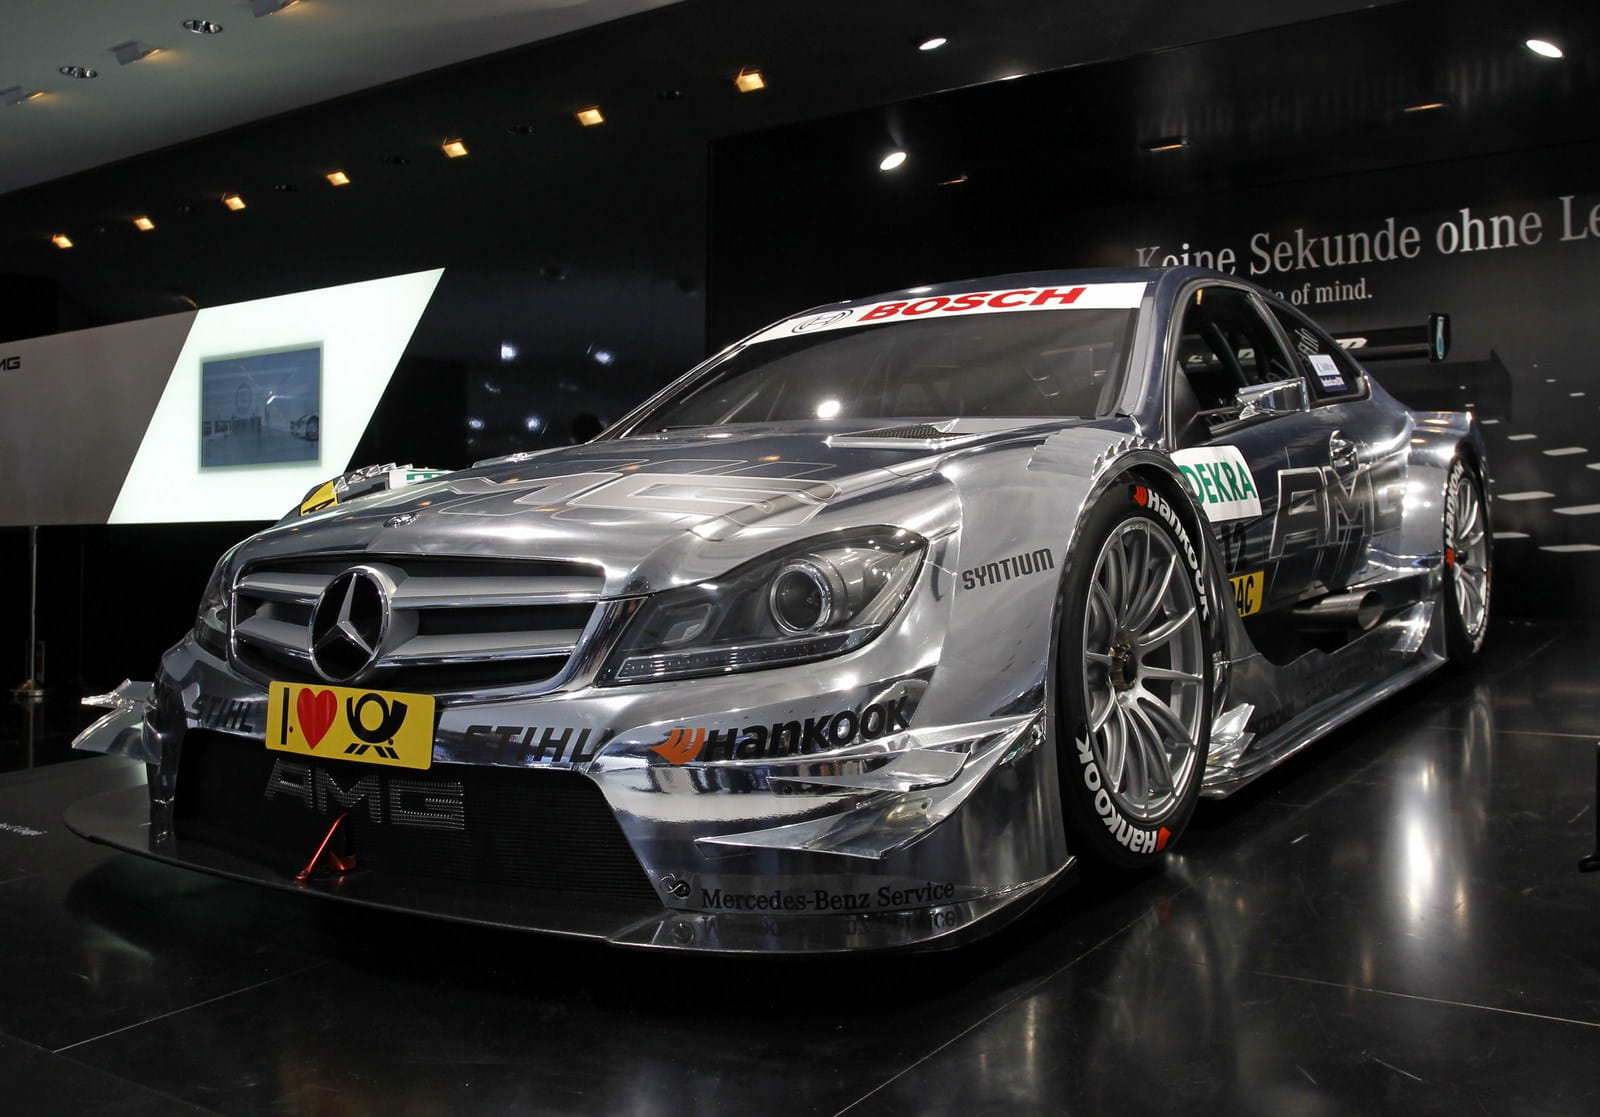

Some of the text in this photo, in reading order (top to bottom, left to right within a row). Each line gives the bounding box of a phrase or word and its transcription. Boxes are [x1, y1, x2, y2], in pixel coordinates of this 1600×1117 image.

[1250, 217, 1421, 275] Sekunde
[1436, 208, 1543, 254] ohne
[857, 287, 1087, 322] BOSCH
[1291, 282, 1311, 306] of
[1315, 277, 1373, 305] mind.
[1177, 460, 1258, 505] DEKRA
[962, 548, 1055, 590] SYNTIUM
[464, 725, 593, 763] STIHL
[264, 758, 465, 830] AMG
[702, 882, 955, 910] Mercedes-Benz Service
